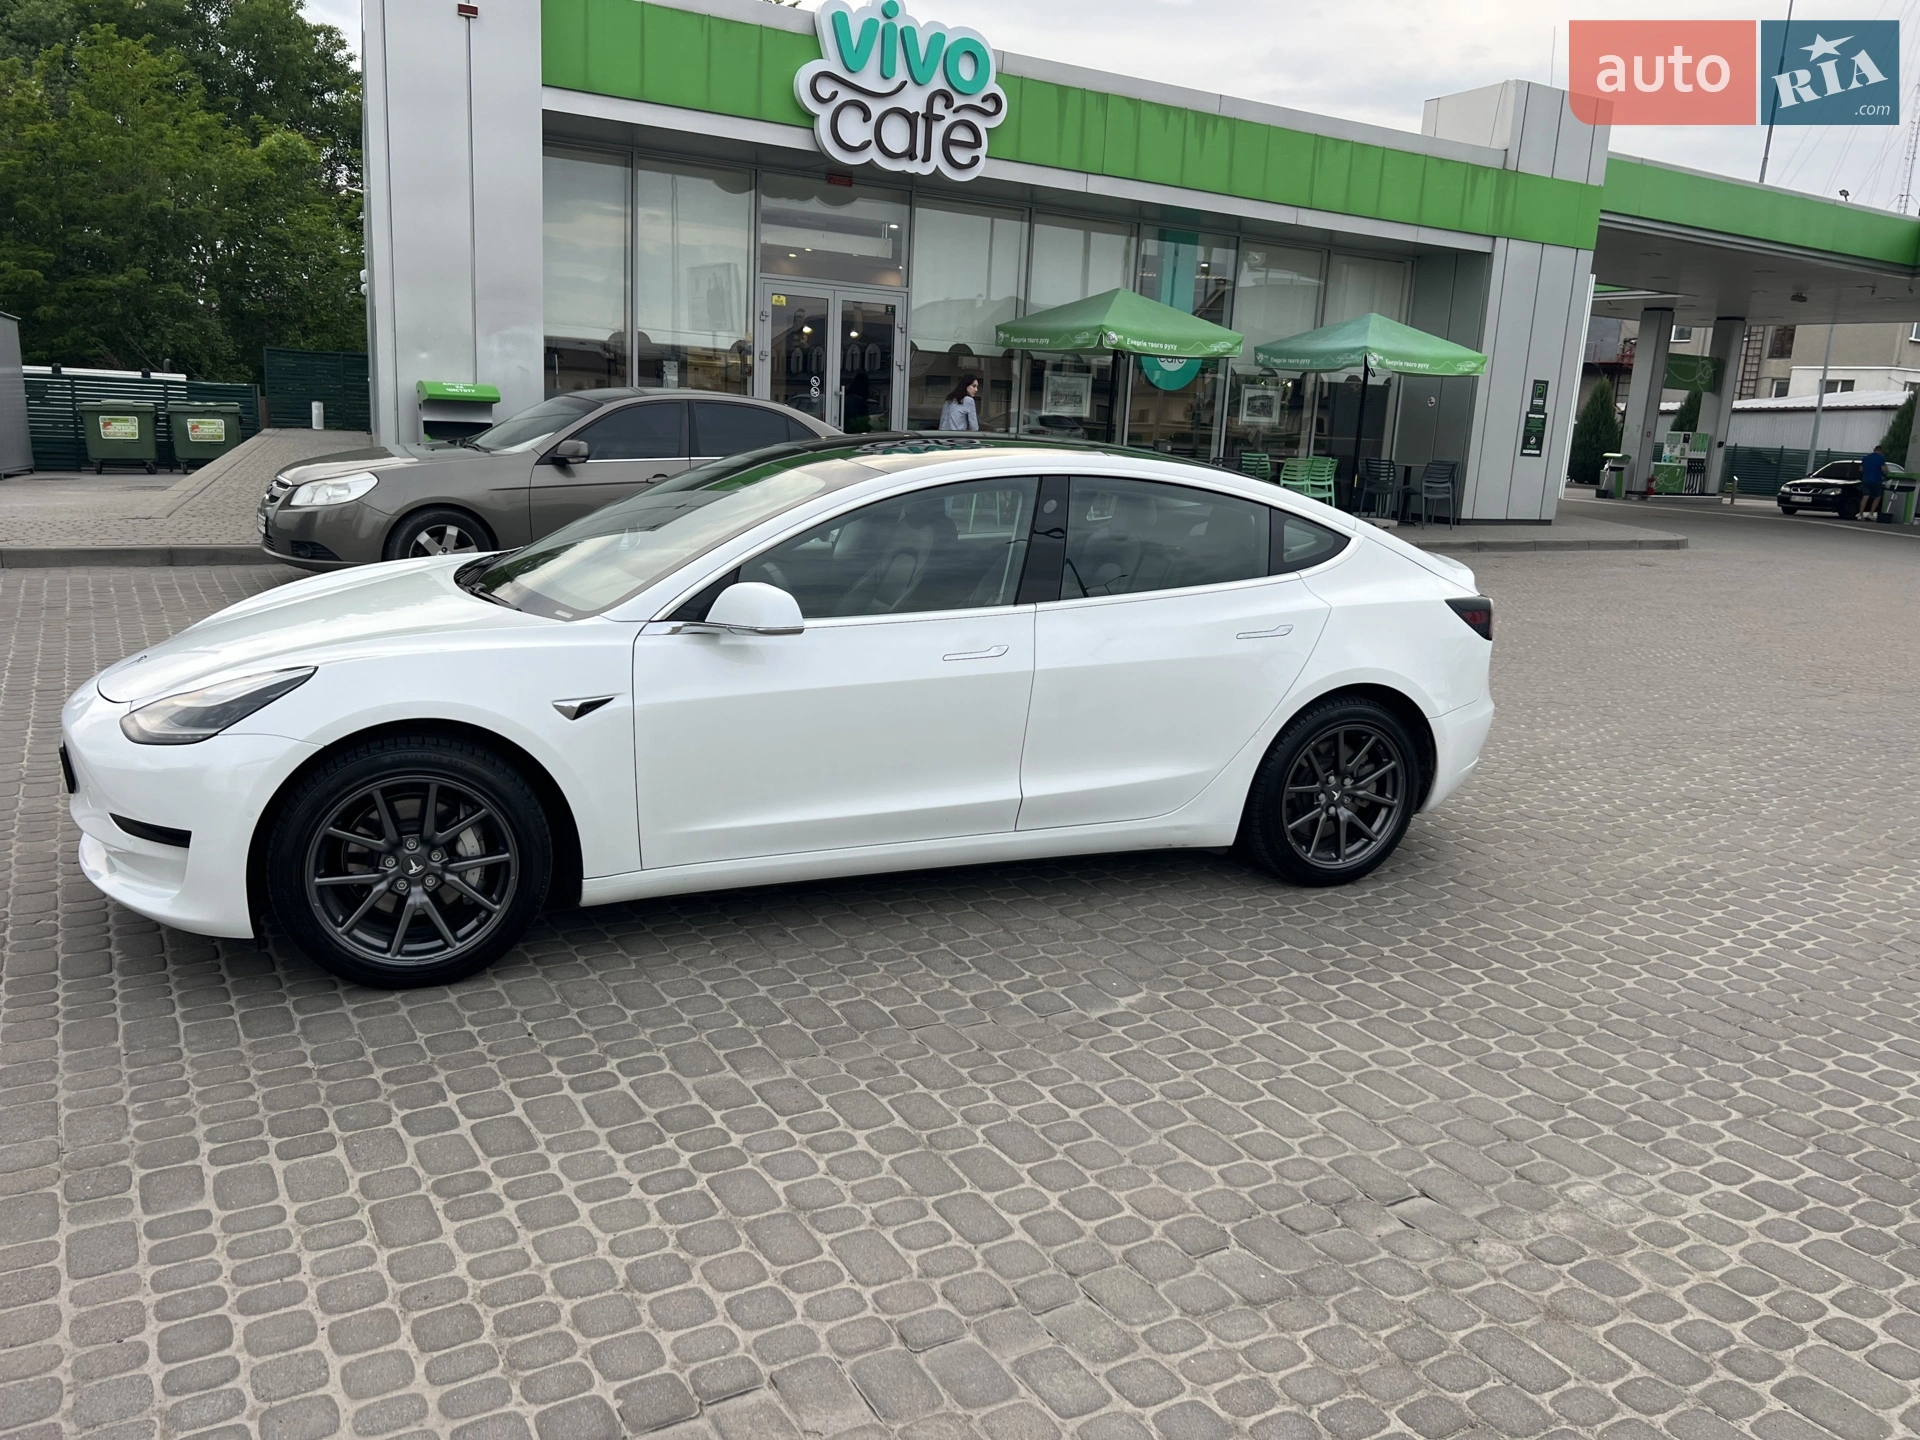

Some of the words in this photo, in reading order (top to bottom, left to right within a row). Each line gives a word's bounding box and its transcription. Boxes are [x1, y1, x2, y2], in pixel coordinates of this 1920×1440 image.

[831, 0, 991, 95] vivo
[1126, 338, 1147, 348] Енергія
[1164, 343, 1178, 351] руху
[1385, 358, 1404, 367] Енергія
[1535, 385, 1544, 397] P
